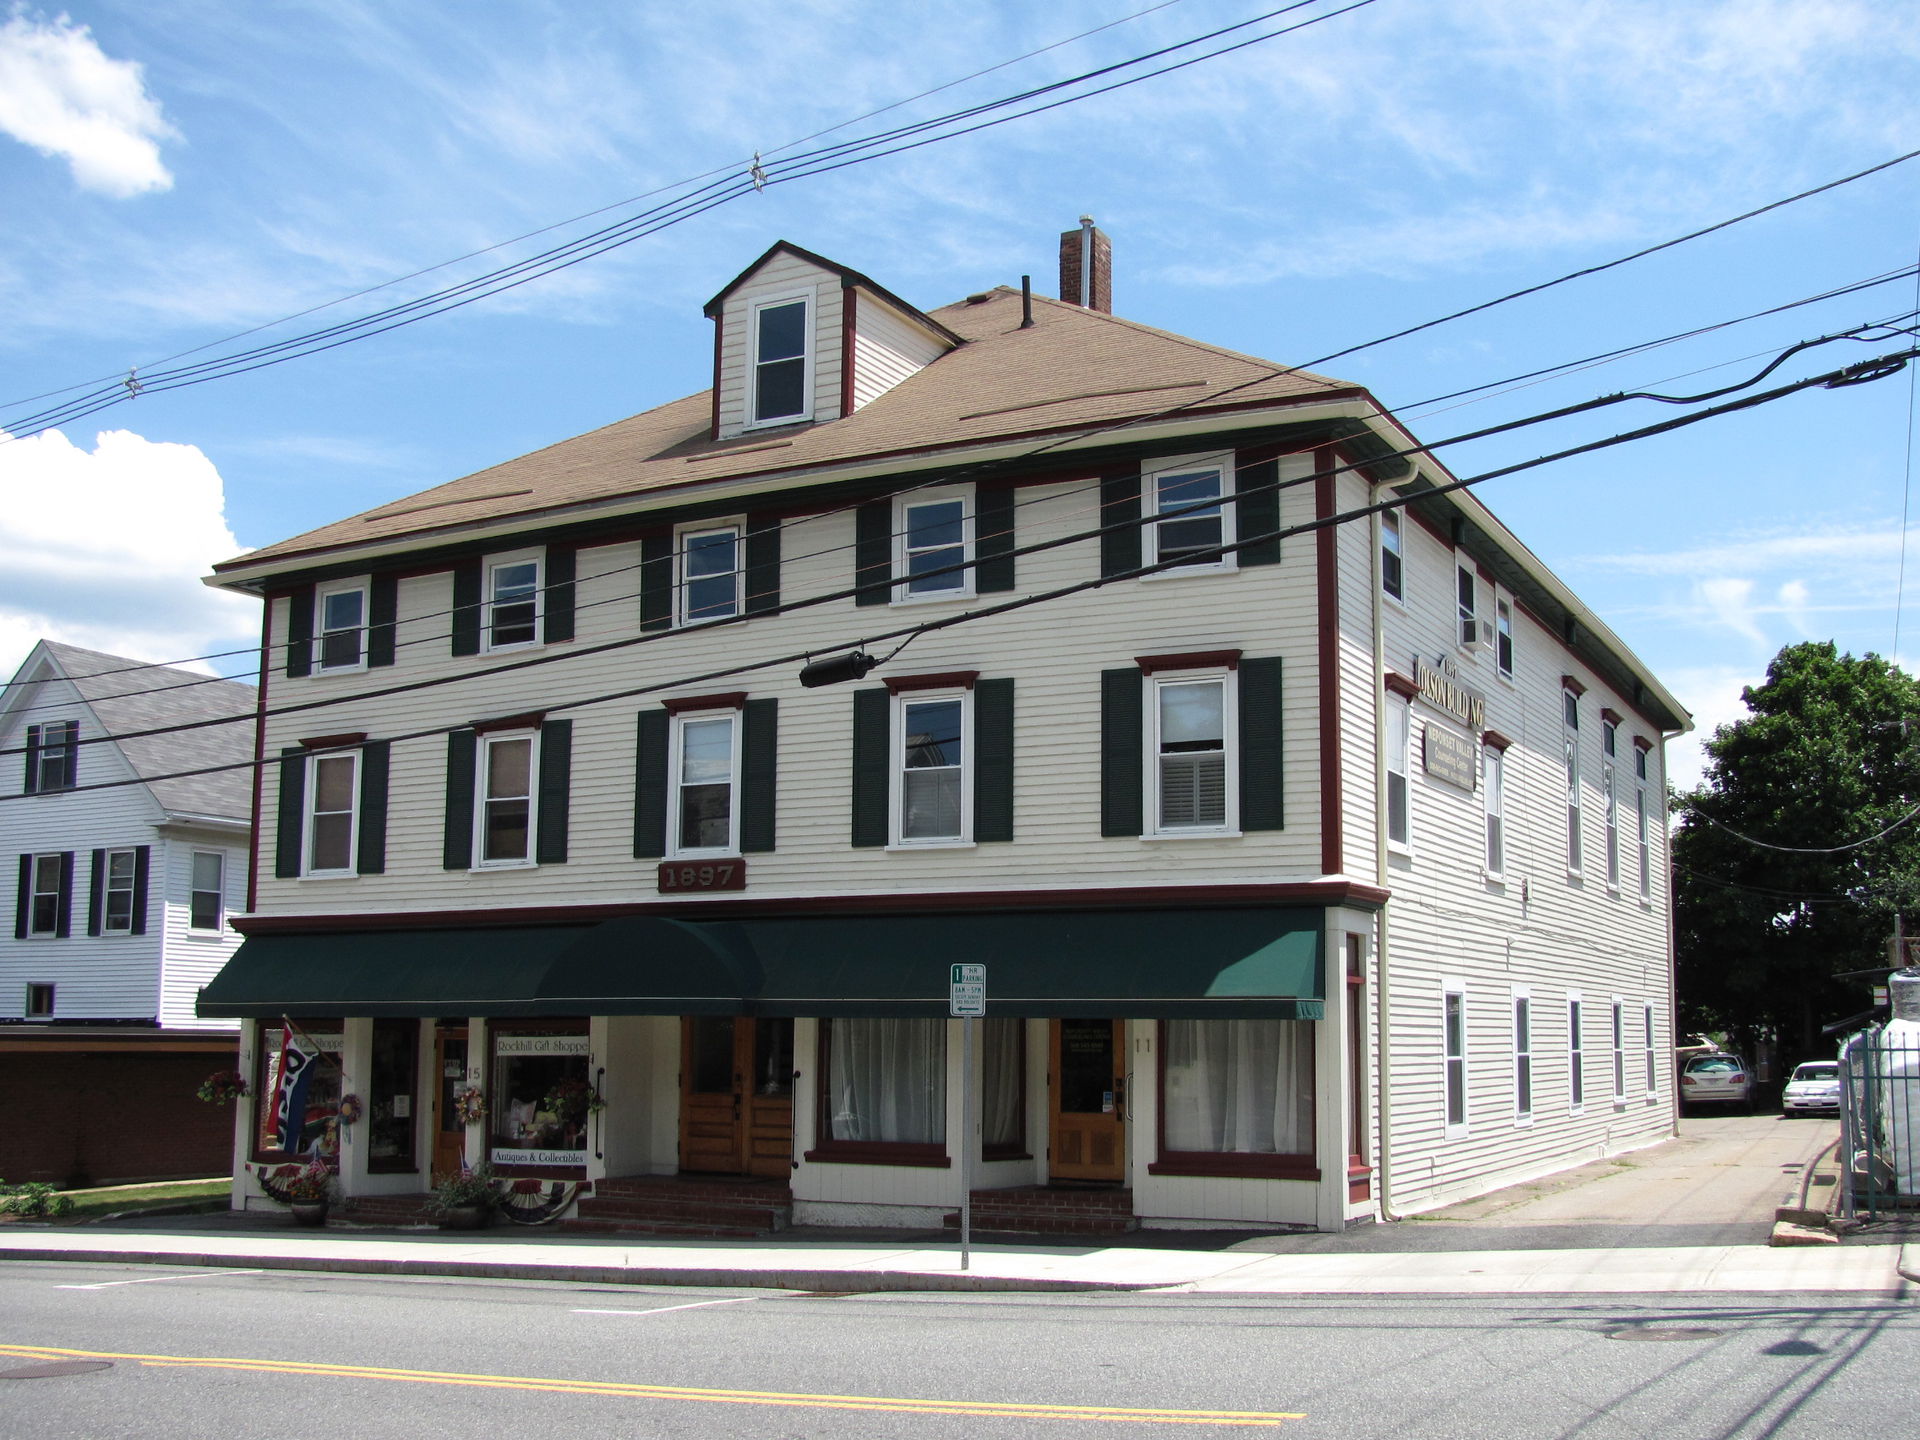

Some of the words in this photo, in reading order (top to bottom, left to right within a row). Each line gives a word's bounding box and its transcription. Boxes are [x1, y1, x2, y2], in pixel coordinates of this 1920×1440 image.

[1420, 666, 1446, 708] OLSON
[666, 865, 734, 887] 1897
[498, 1040, 532, 1051] Rockhill
[534, 1040, 551, 1051] Gift
[553, 1040, 589, 1053] Shoppe
[468, 1067, 481, 1079] 15
[495, 1151, 528, 1163] Antiques
[529, 1152, 536, 1162] &
[538, 1152, 583, 1163] Collectibles
